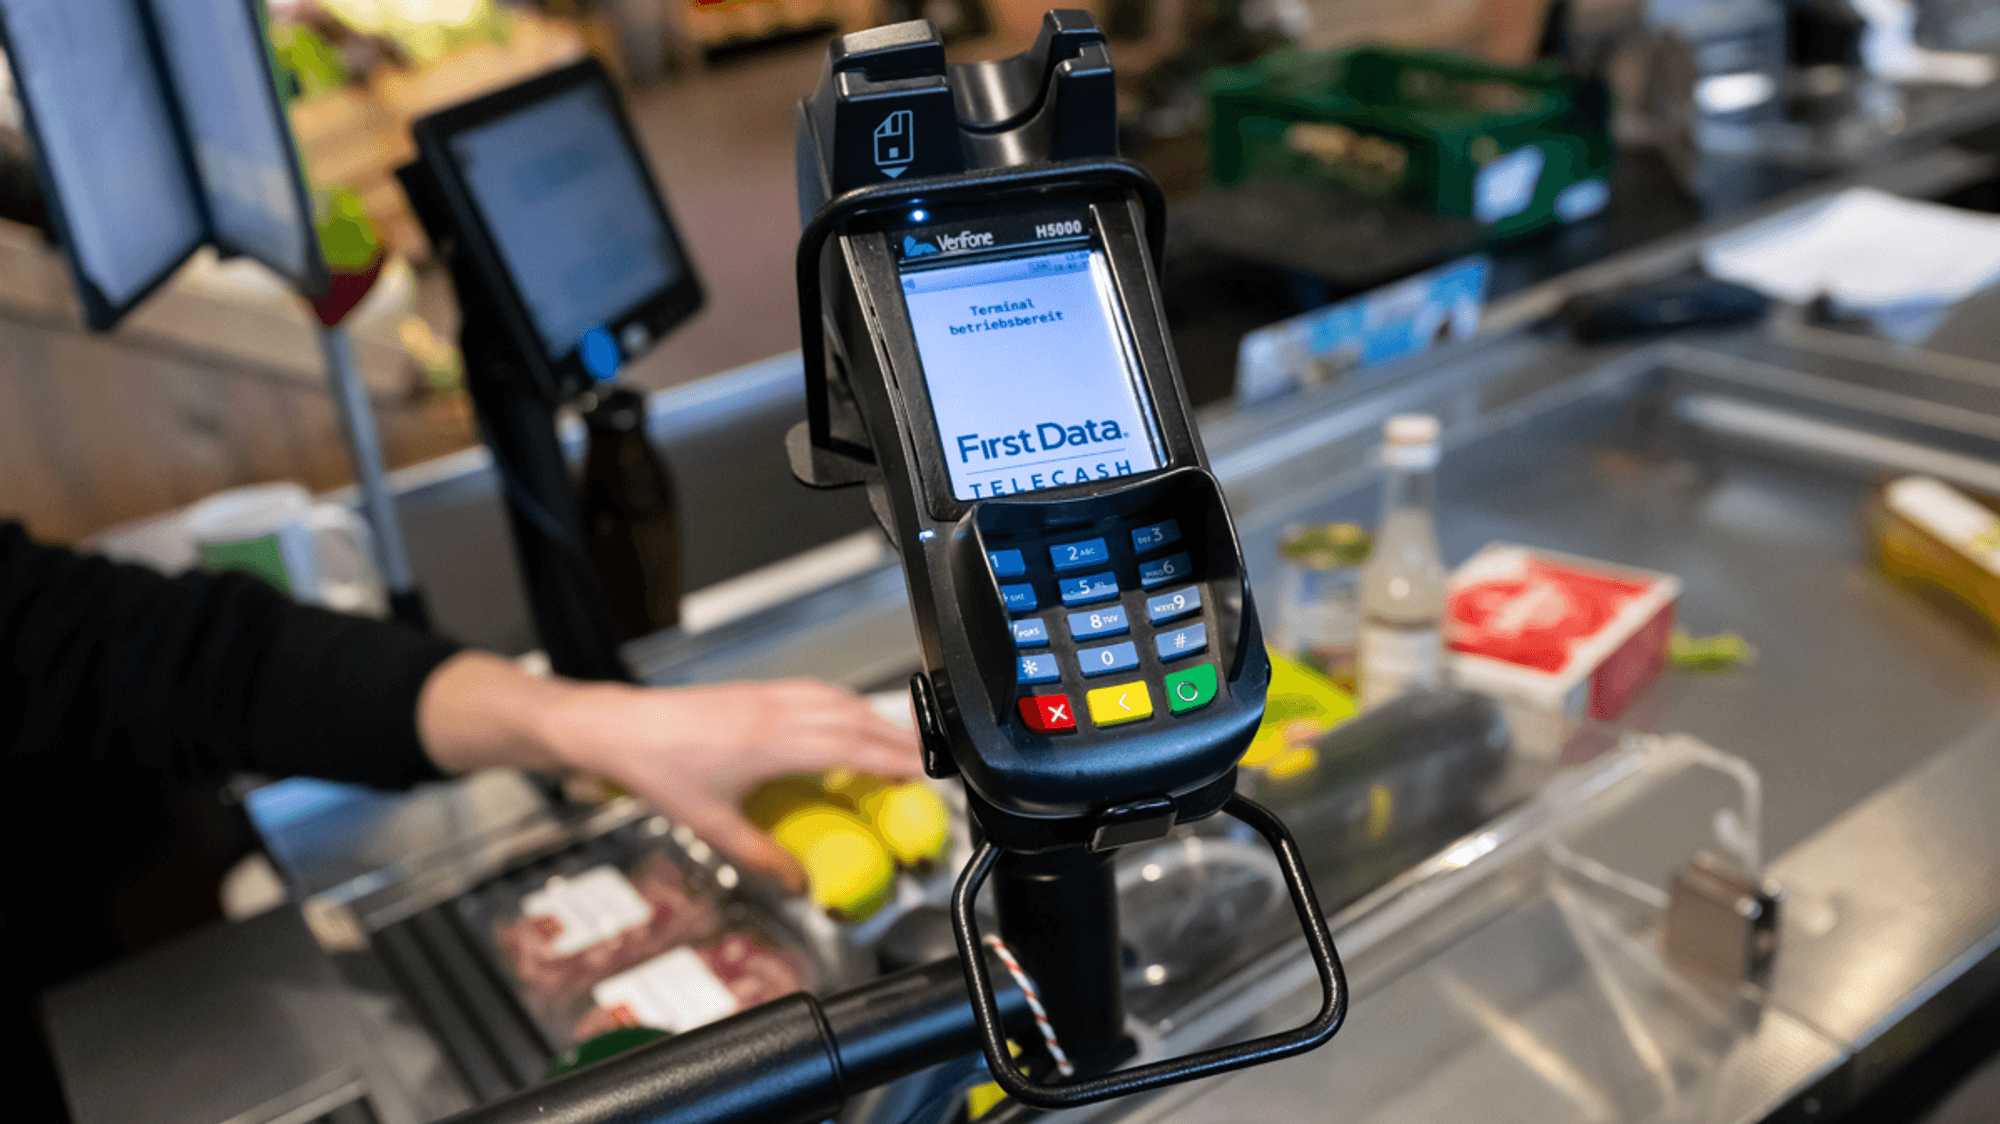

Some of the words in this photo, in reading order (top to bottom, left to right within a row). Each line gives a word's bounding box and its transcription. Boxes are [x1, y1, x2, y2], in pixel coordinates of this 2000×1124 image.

[1035, 220, 1082, 238] H5000
[936, 231, 994, 252] VeriFone
[969, 298, 1034, 316] Terminal
[949, 310, 1063, 335] betriebsbereit
[957, 433, 1036, 463] First
[969, 460, 1133, 499] TELECASH
[1151, 526, 1163, 543] 3
[990, 554, 999, 568] 1
[1065, 546, 1079, 561] 2
[1162, 560, 1175, 575] 6
[1078, 579, 1090, 595] 5
[1172, 594, 1185, 610] 9
[1089, 614, 1103, 629] 8
[1101, 650, 1114, 666] 0
